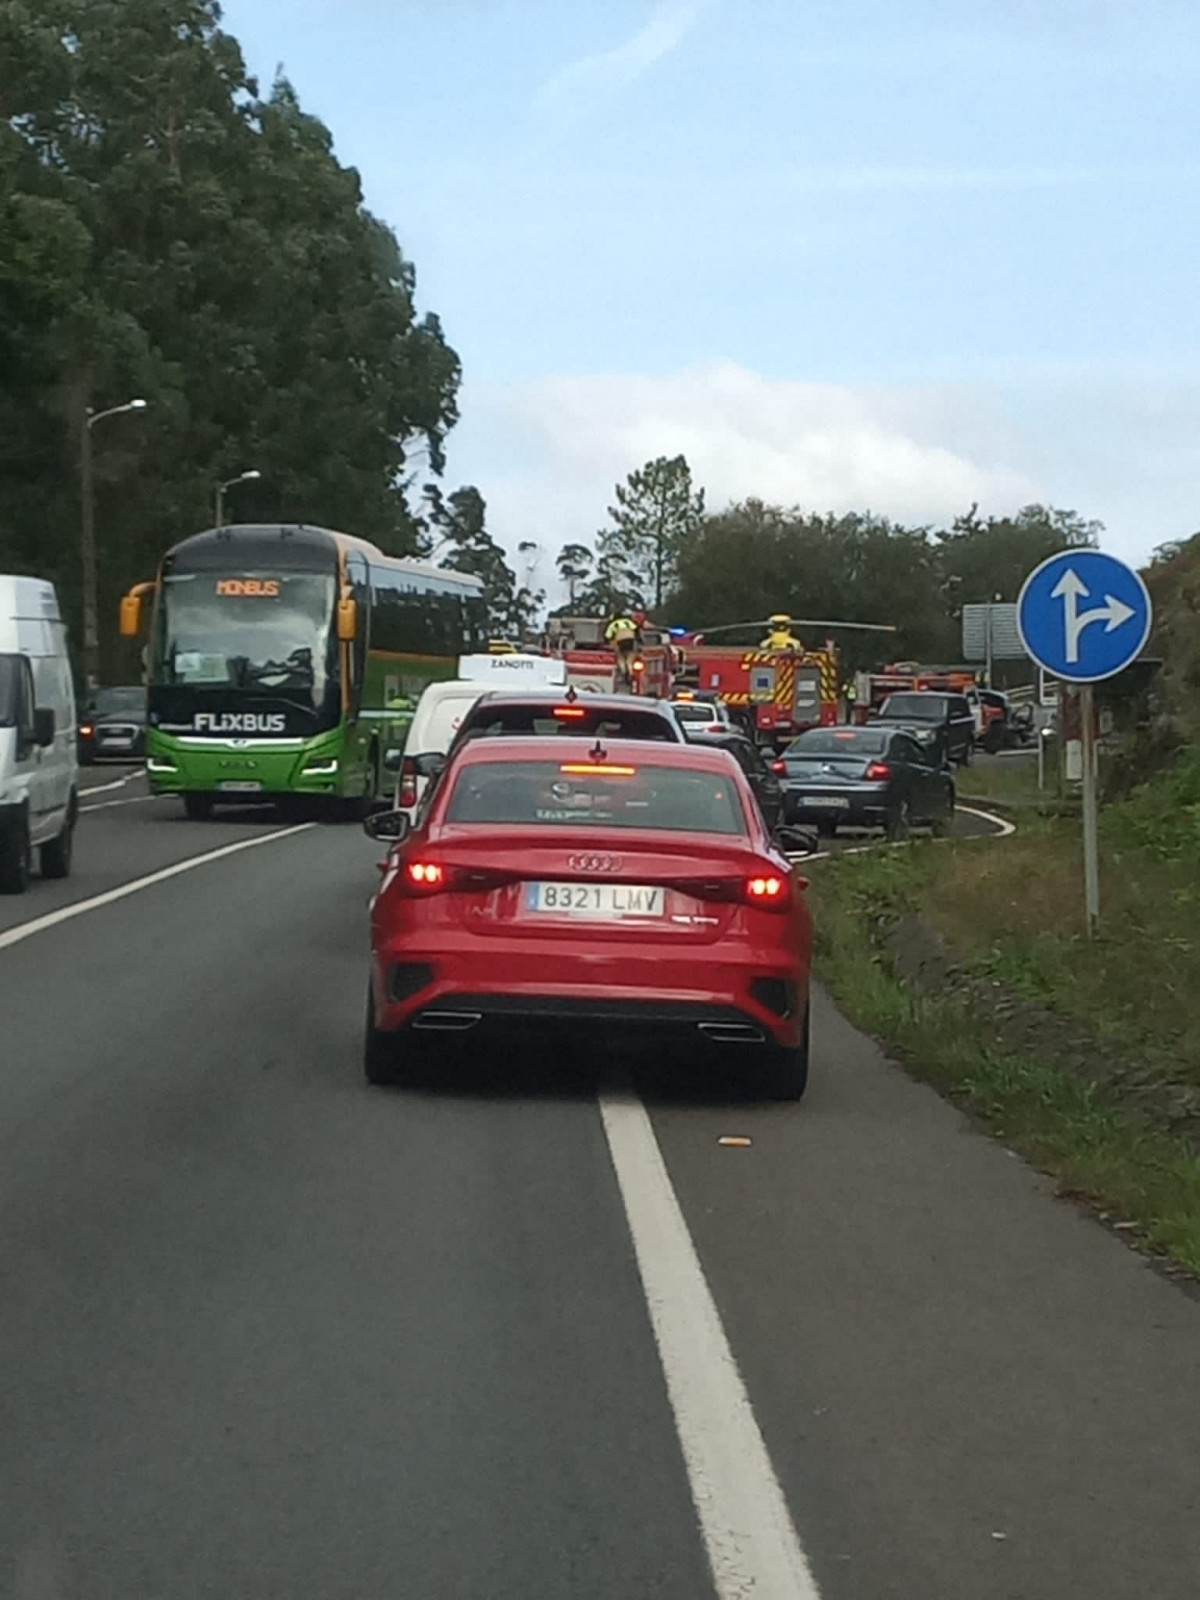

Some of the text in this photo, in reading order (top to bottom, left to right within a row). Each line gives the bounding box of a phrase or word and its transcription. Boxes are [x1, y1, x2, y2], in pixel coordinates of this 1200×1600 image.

[216, 580, 280, 596] MONBUS
[491, 659, 535, 669] ZANOTTI
[544, 886, 659, 911] 8321 LMV
